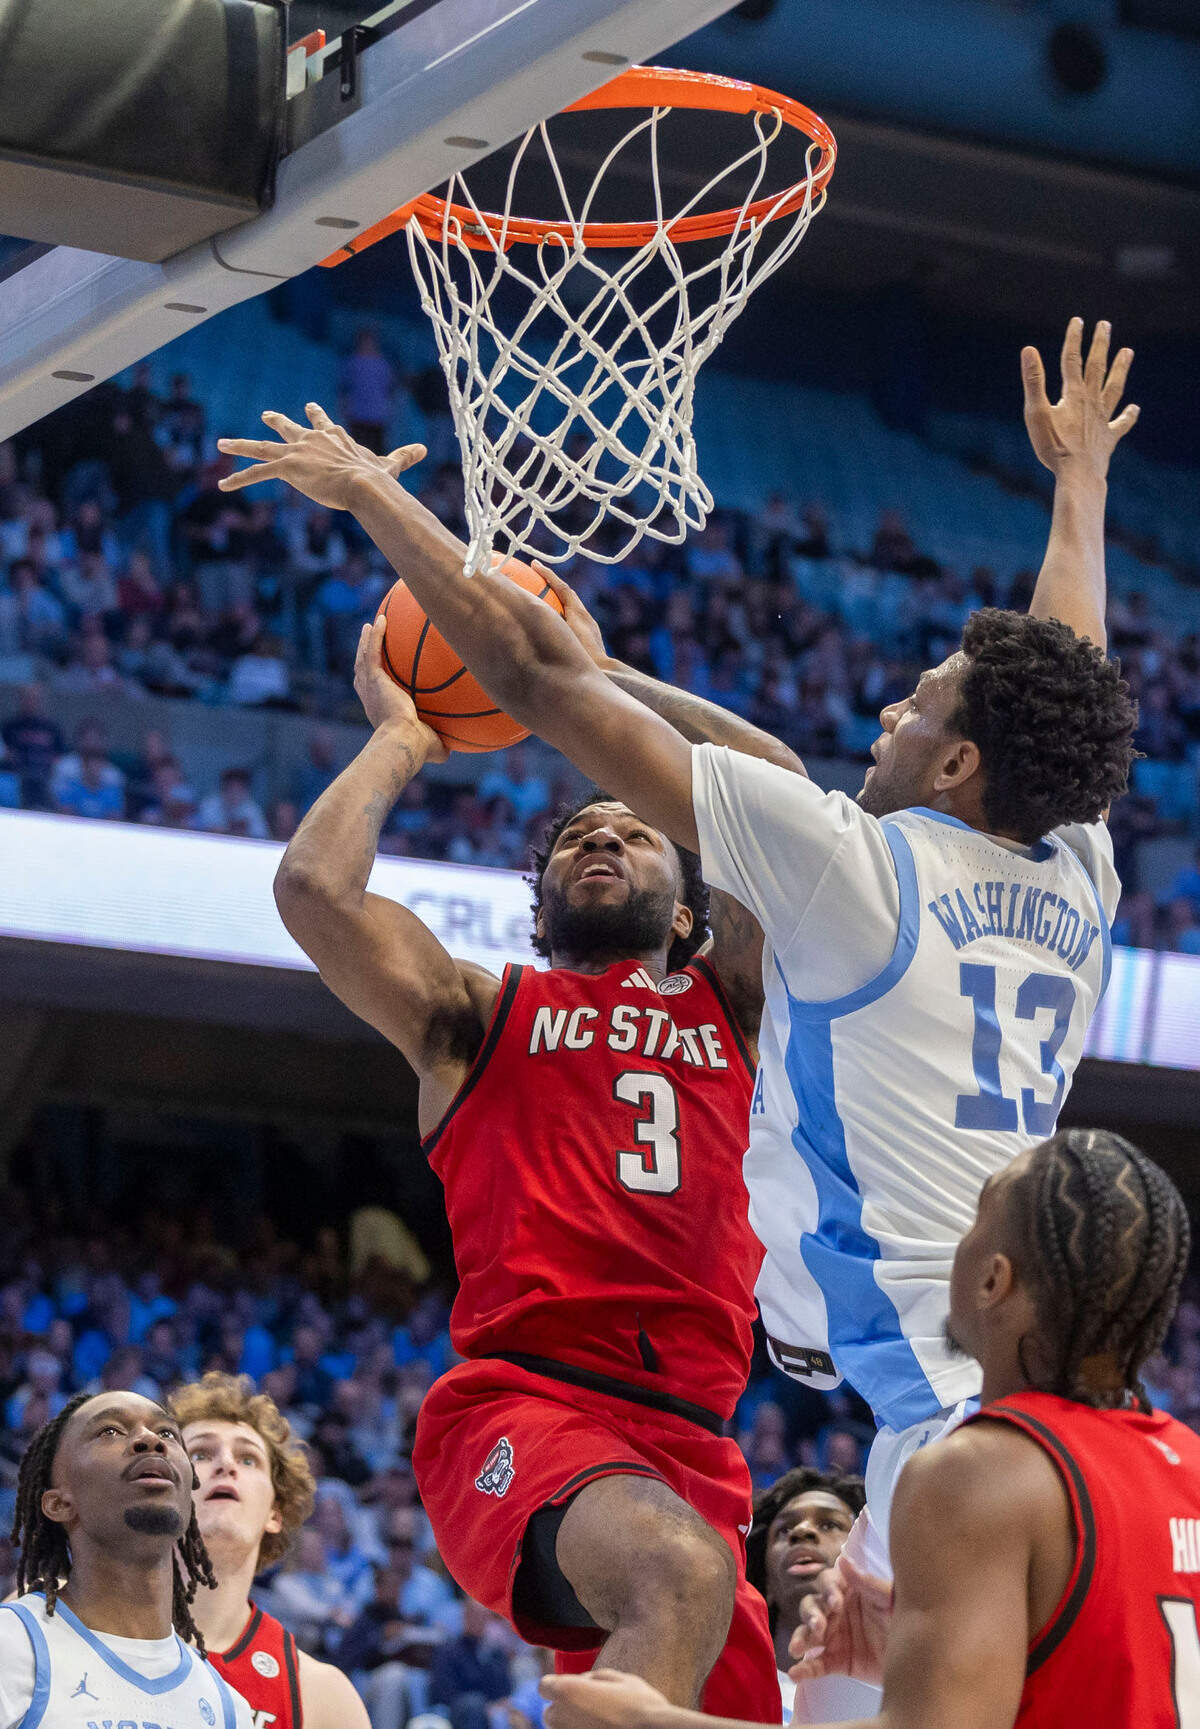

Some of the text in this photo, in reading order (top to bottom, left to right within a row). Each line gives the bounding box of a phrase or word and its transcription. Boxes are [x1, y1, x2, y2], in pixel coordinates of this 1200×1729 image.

[927, 881, 1100, 972] WASHINGTON
[527, 1003, 729, 1070] NC STATE
[954, 961, 1077, 1138] 13
[612, 1070, 682, 1198] 3
